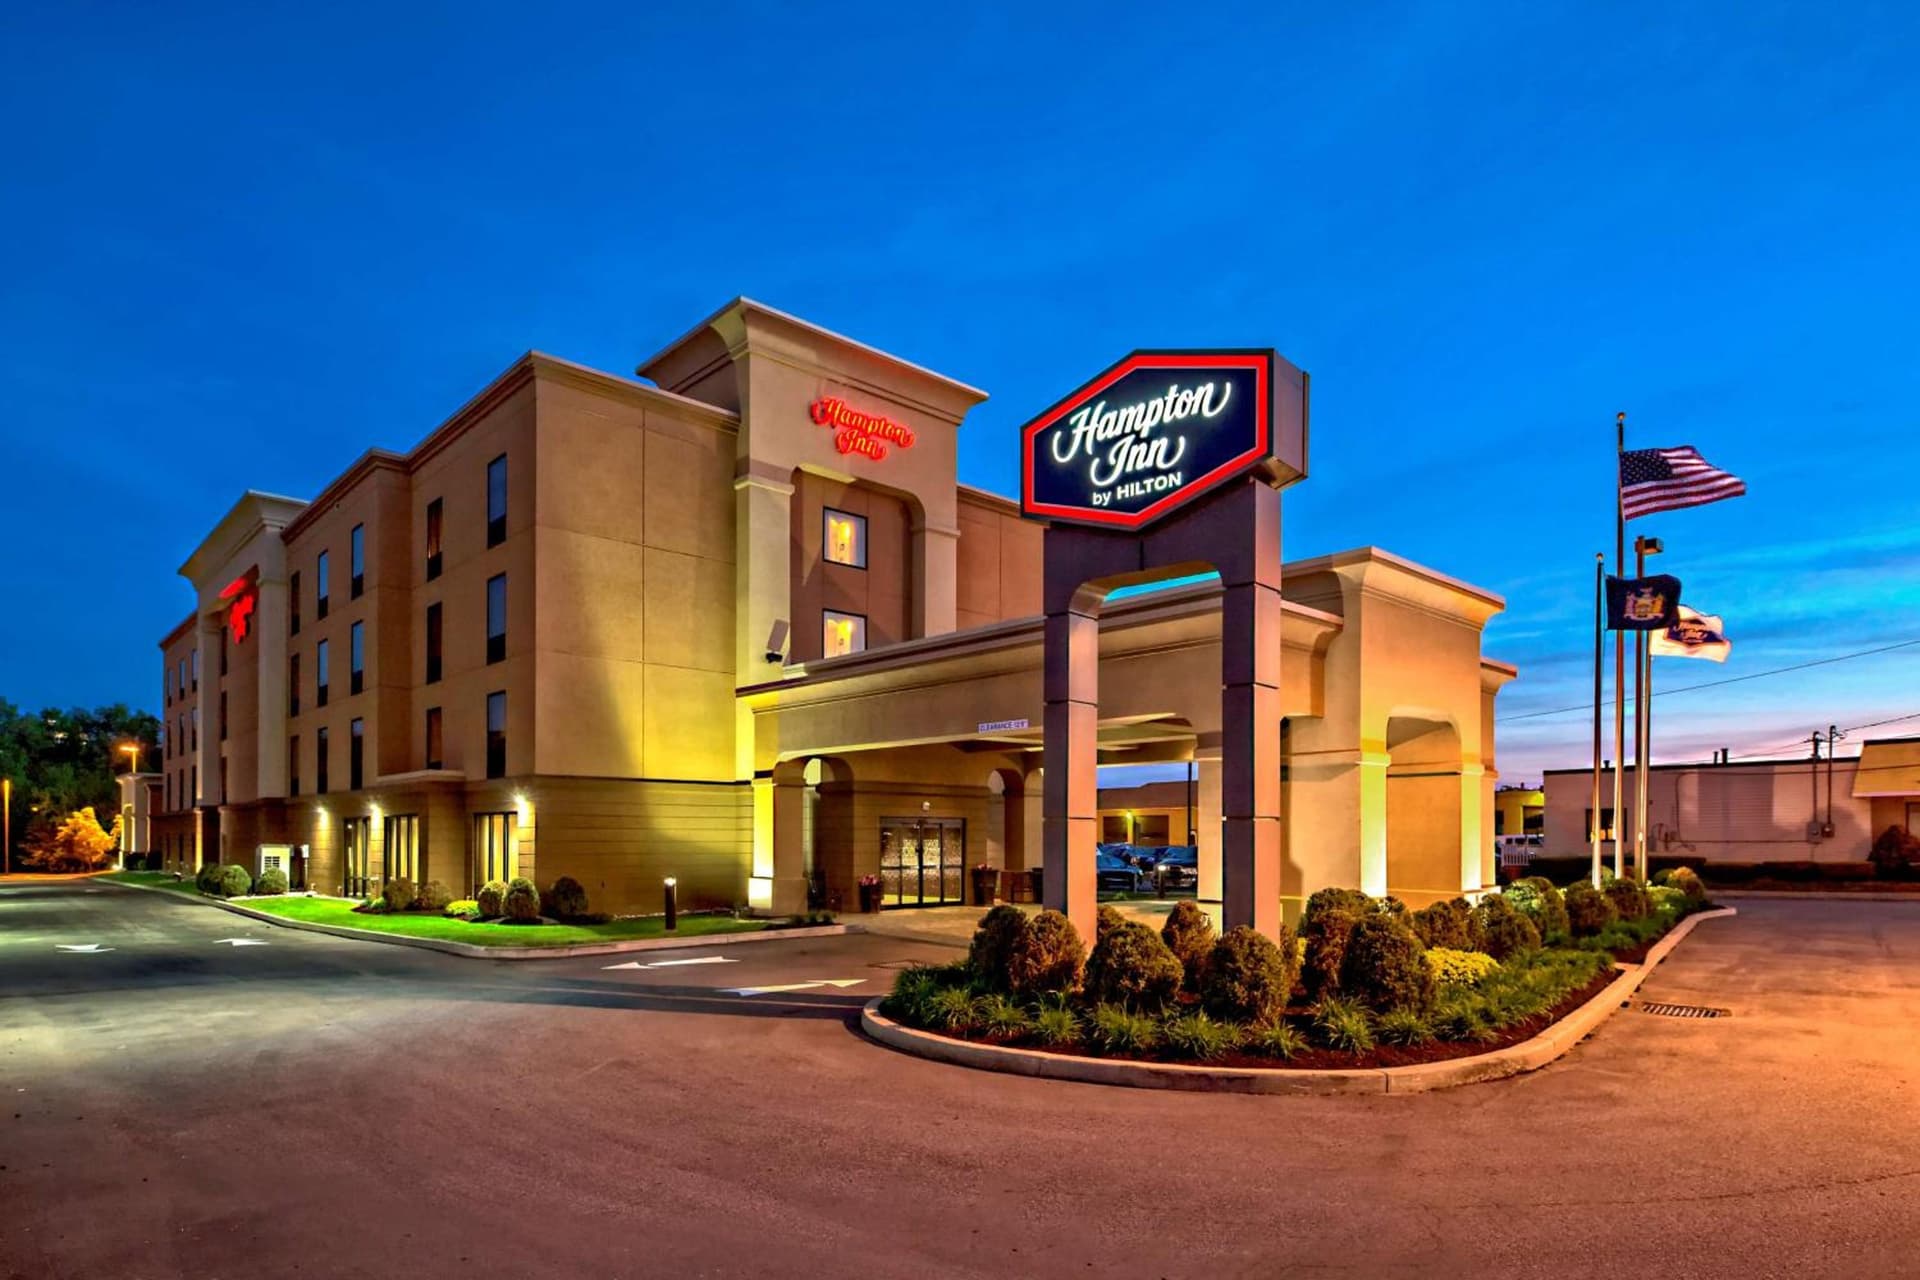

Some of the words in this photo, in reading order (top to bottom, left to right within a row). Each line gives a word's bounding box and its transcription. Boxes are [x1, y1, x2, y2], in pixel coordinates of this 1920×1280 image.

[810, 397, 916, 448] Hampton
[836, 429, 888, 461] Inn
[1053, 381, 1231, 462] Hampton
[1090, 434, 1185, 486] Inn
[1092, 491, 1112, 506] by
[1116, 472, 1182, 499] HILTON
